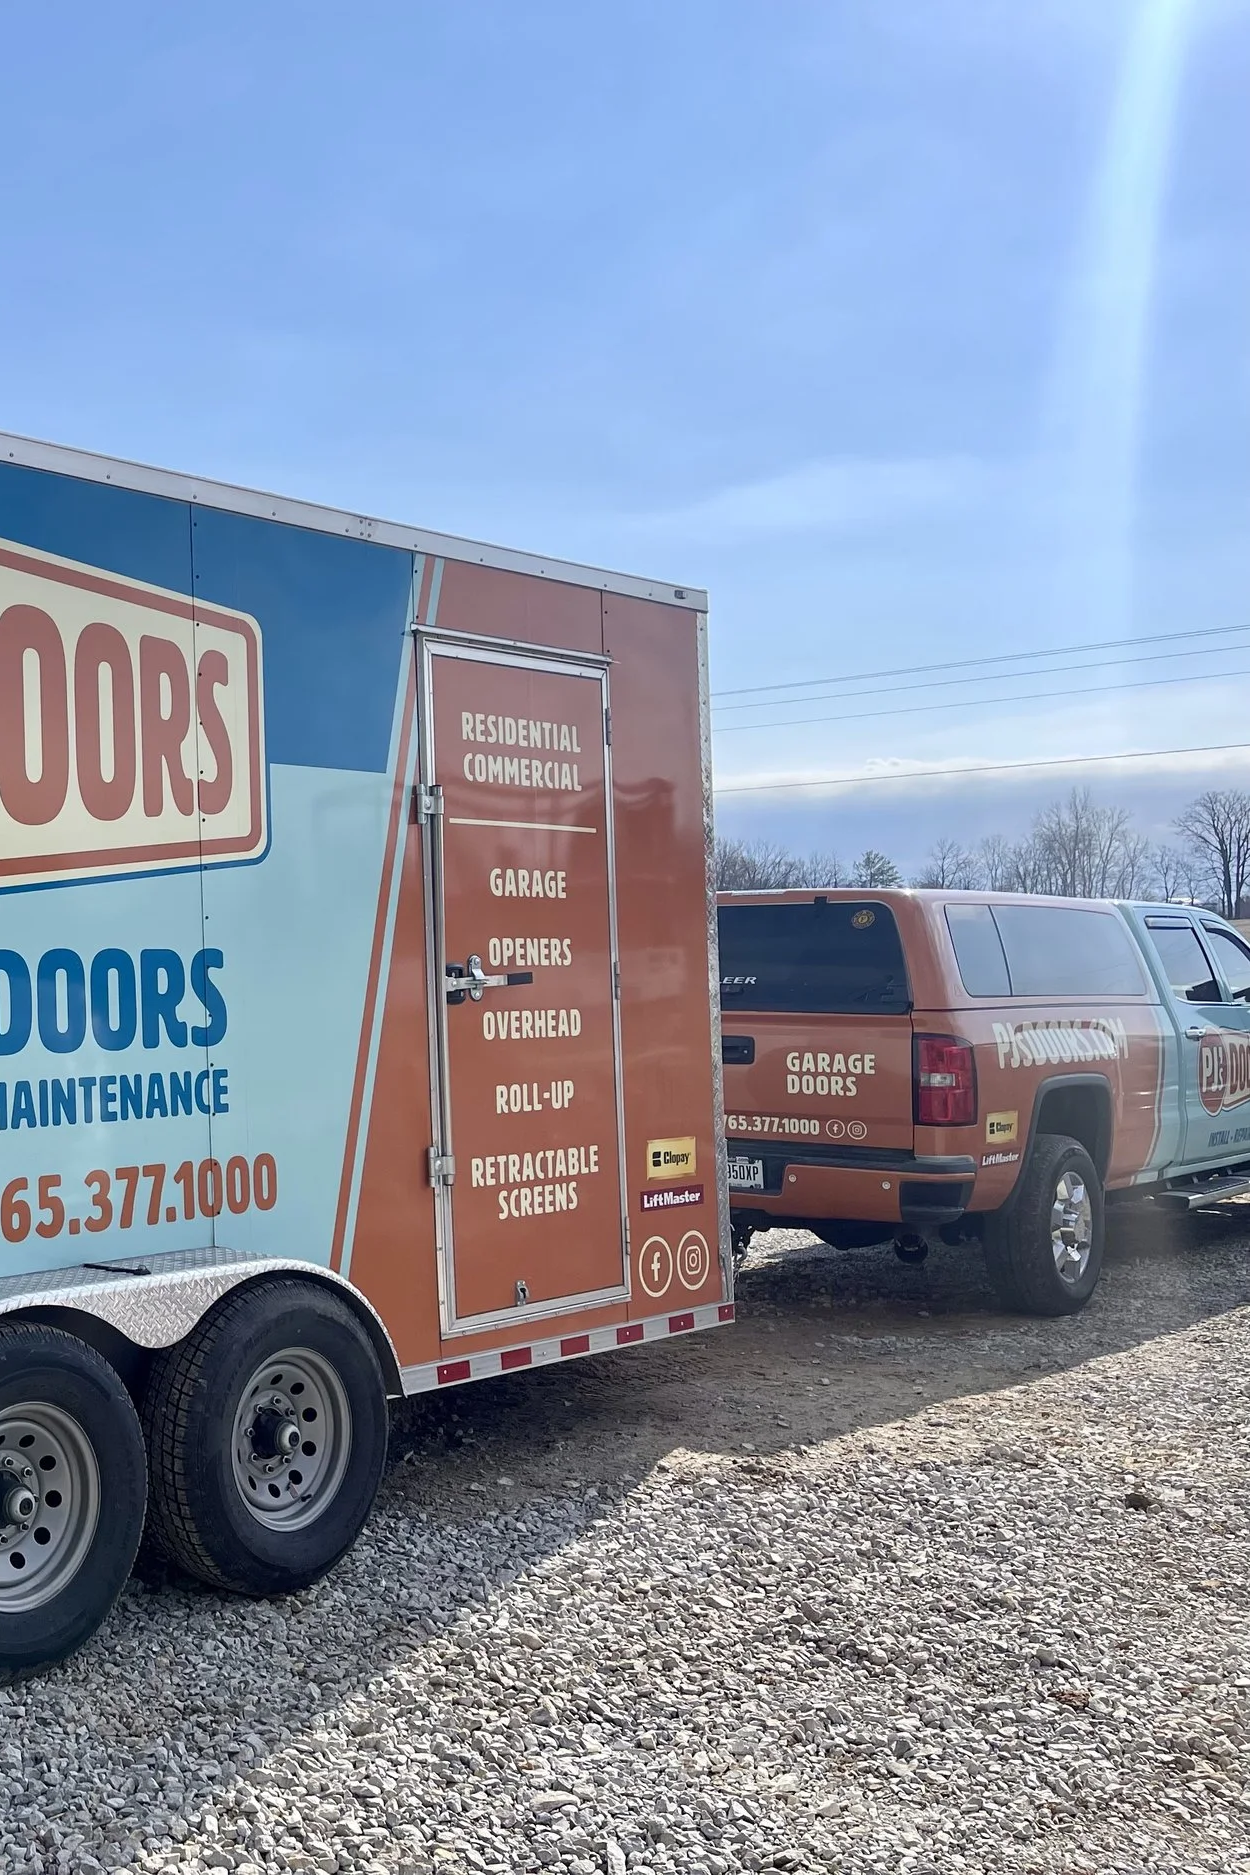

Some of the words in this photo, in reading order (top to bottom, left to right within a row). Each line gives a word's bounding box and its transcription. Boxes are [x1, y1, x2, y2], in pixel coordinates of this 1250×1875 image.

[461, 711, 581, 753] RESIDENTIAL
[463, 752, 582, 791] COMMERCIAL
[489, 868, 567, 899] GARAGE
[488, 937, 572, 966] OPENERS
[720, 976, 757, 985] EER
[482, 1008, 582, 1041] OVERHEAD
[786, 1052, 876, 1075] GARAGE
[495, 1080, 575, 1114] ROLL-UP
[786, 1074, 857, 1097] DOORS
[471, 1145, 599, 1188] RETRACTABLE
[664, 1151, 690, 1166] Clopay
[981, 1152, 1019, 1166] LiftMaster
[498, 1182, 578, 1220] SCREENS
[643, 1190, 701, 1209] LiftMaster
